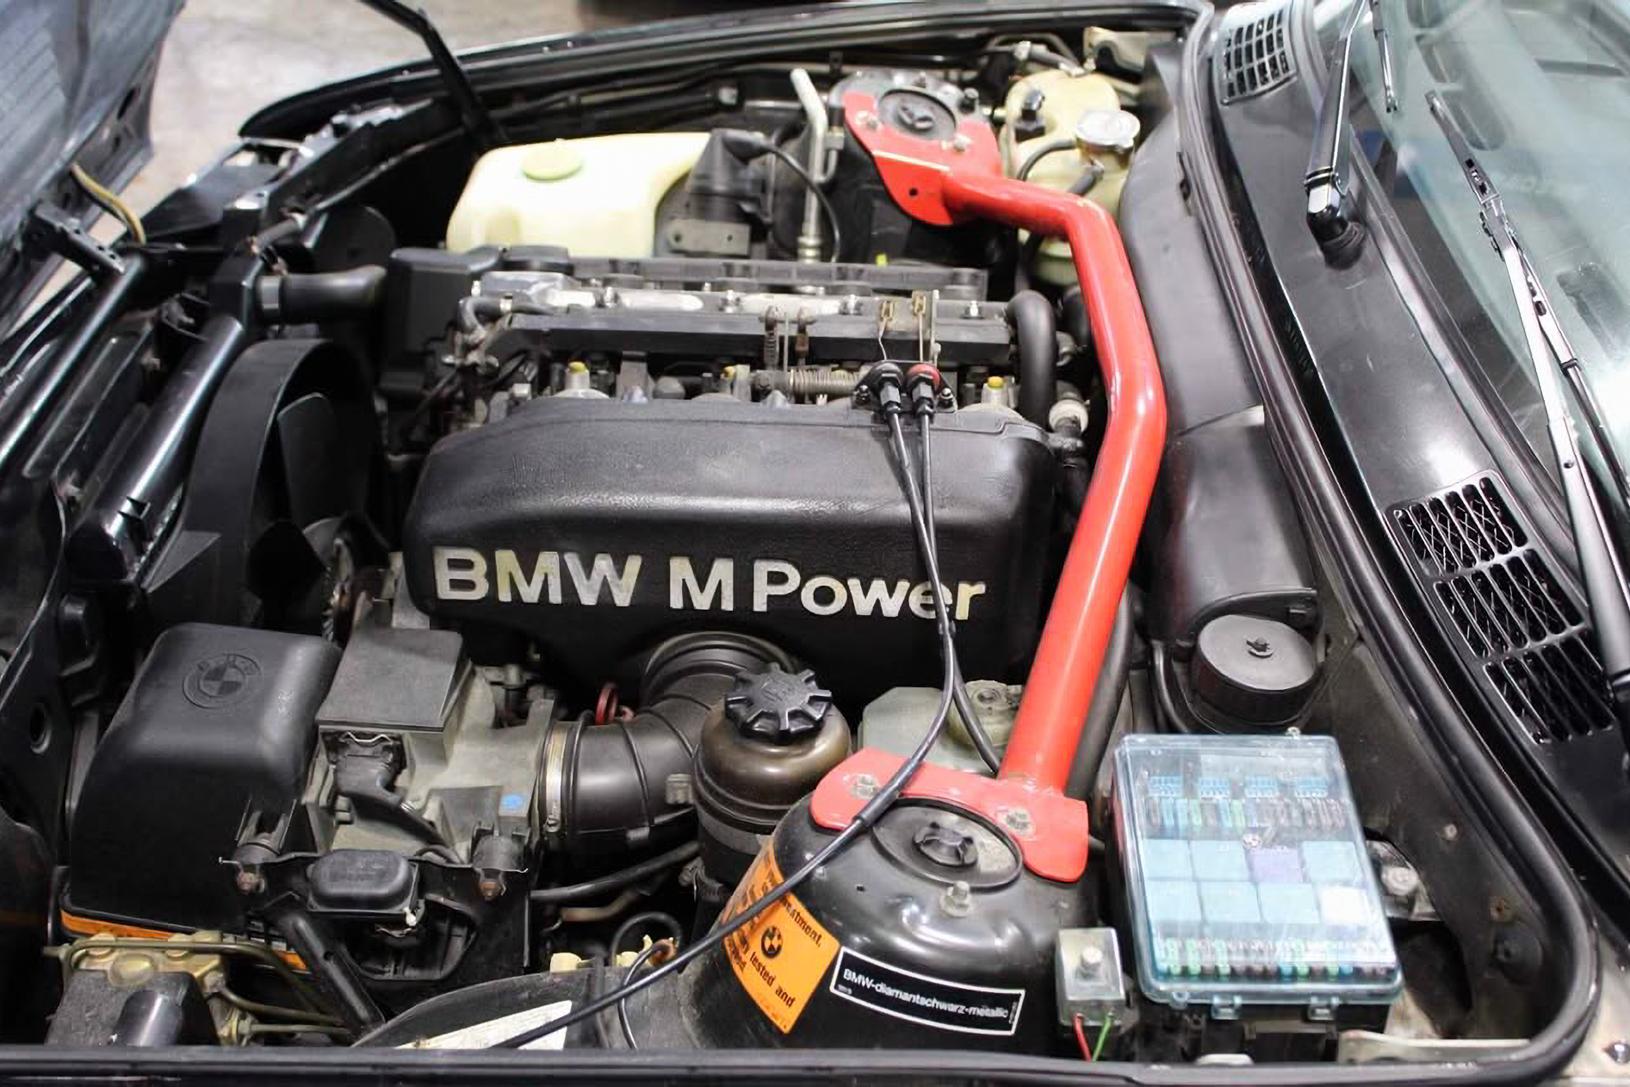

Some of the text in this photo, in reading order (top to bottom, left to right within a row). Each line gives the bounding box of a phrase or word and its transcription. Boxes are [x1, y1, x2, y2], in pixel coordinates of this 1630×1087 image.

[433, 547, 987, 621] BMW M Power
